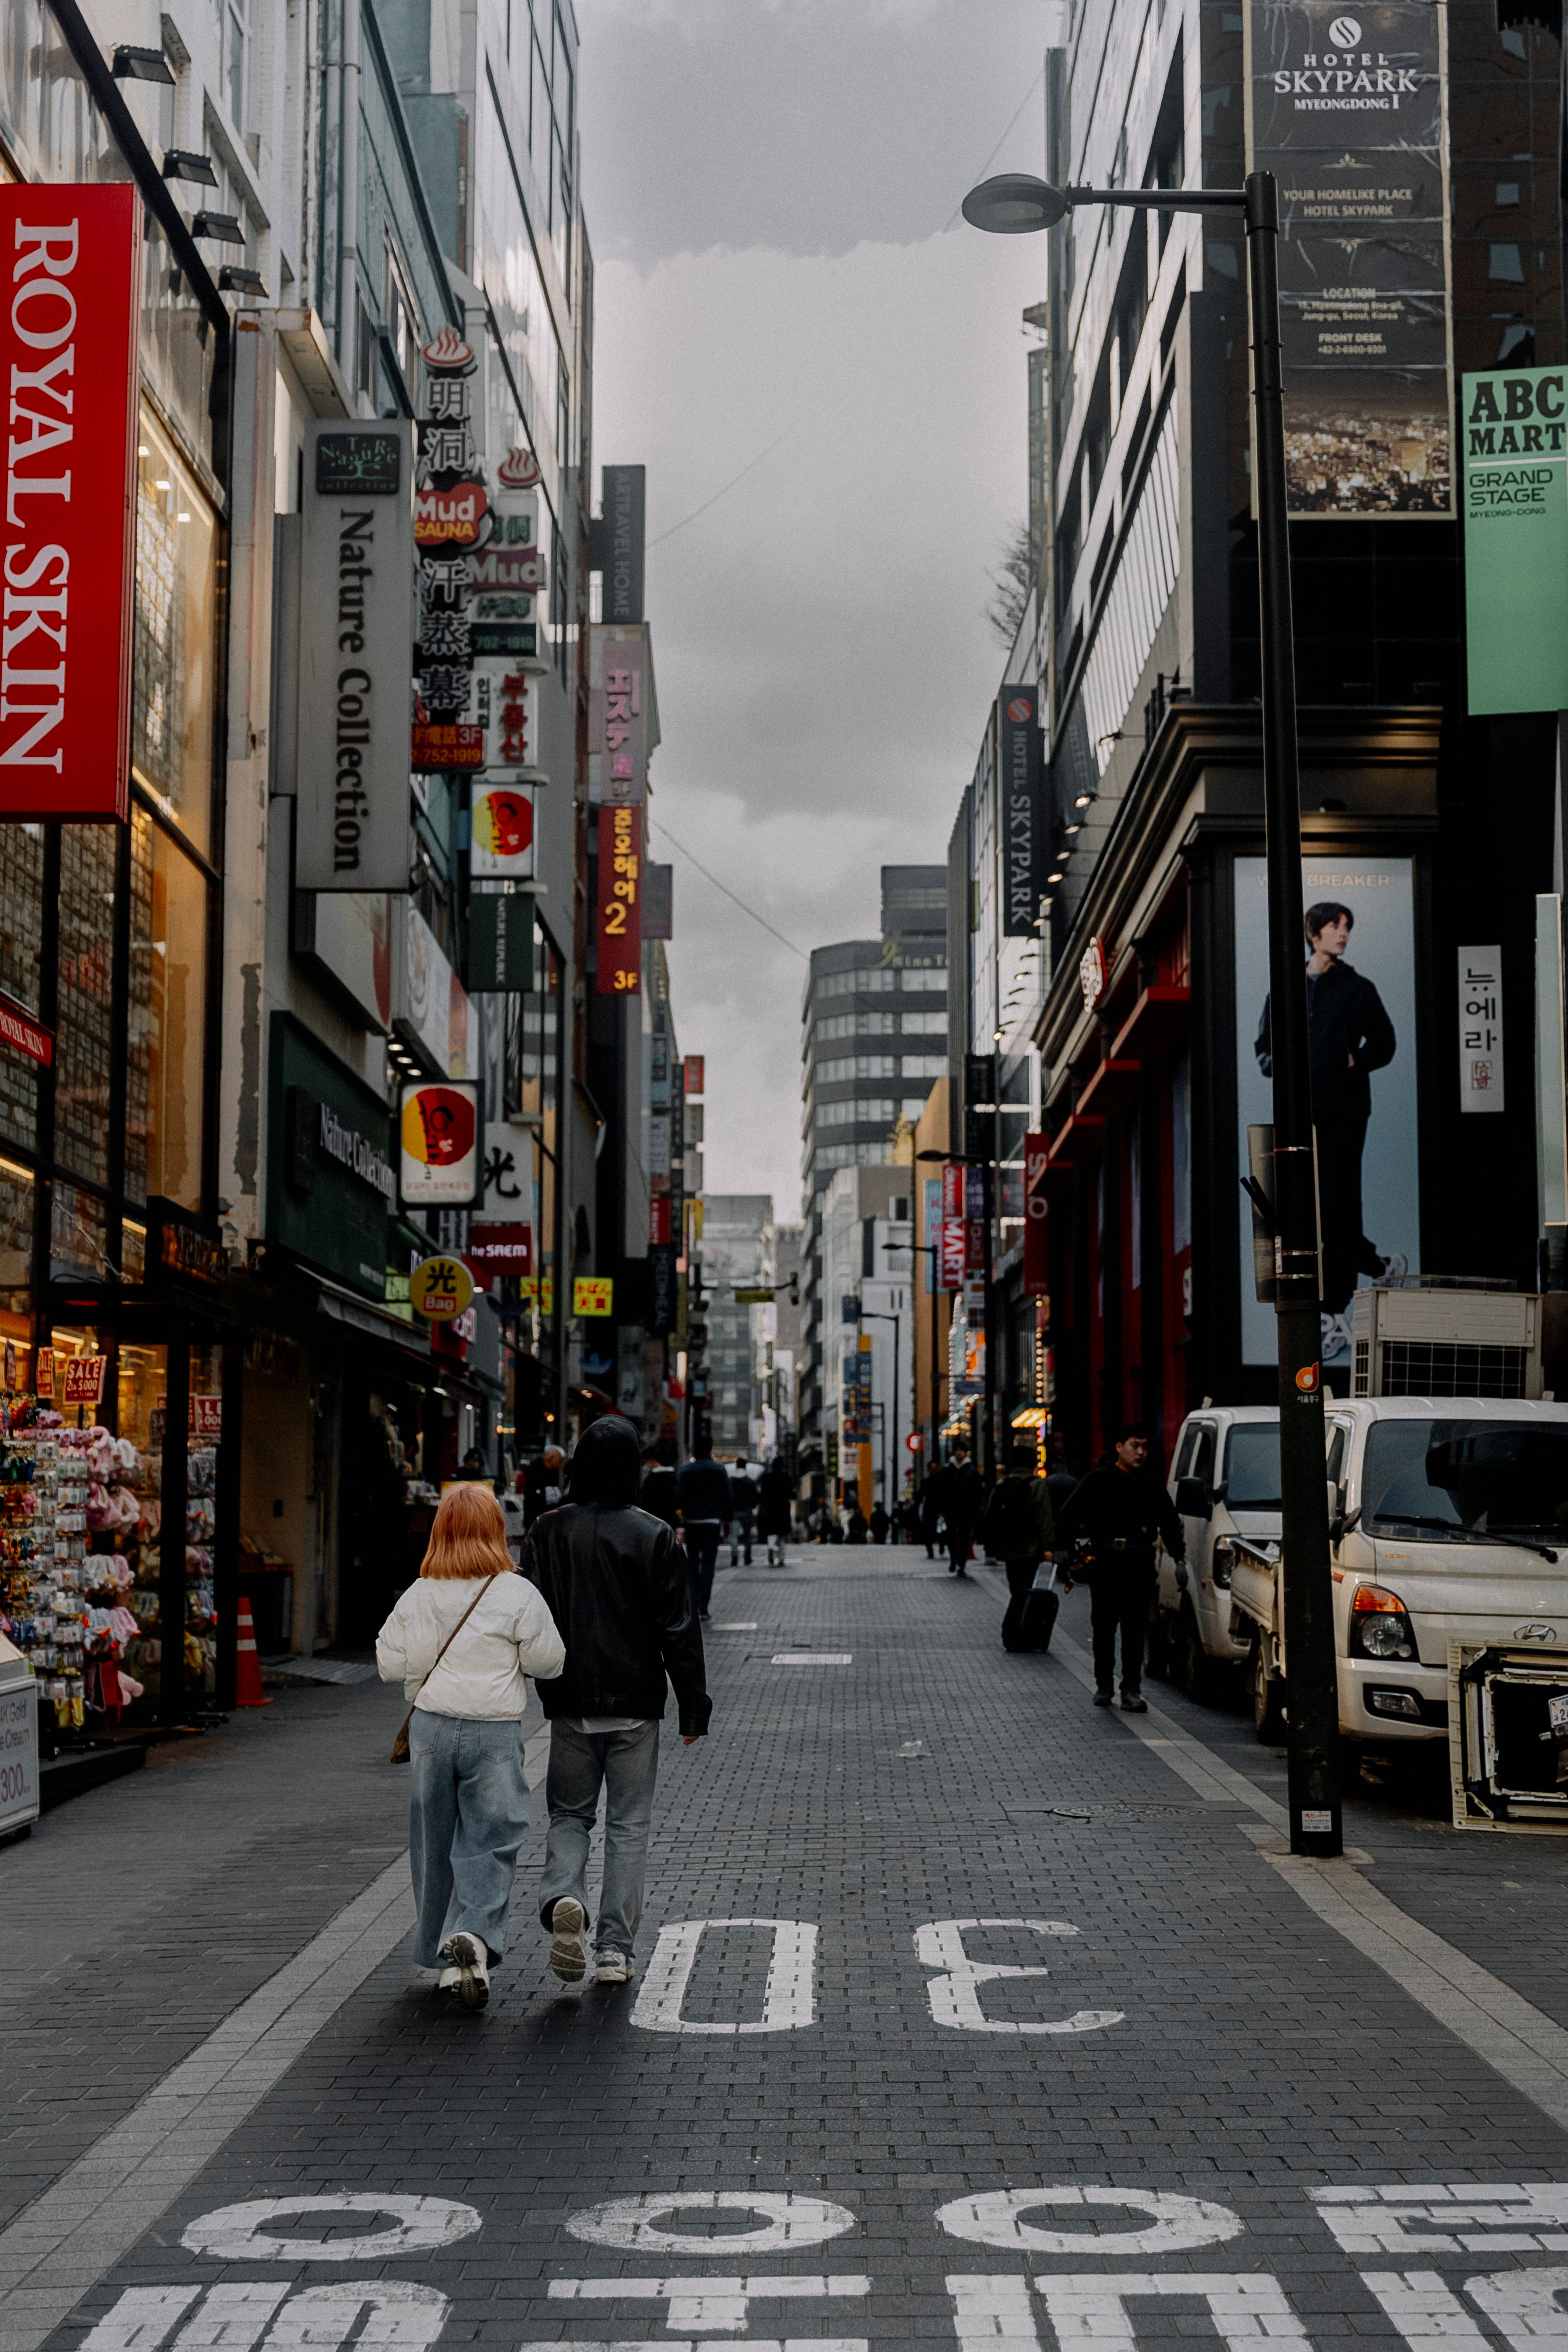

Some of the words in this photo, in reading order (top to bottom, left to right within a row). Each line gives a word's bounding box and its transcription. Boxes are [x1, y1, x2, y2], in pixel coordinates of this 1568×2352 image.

[1304, 53, 1389, 67] HOTEL
[1274, 69, 1418, 94] SKYPARK
[1295, 98, 1390, 110] MYEONGDONG
[1283, 189, 1315, 201] YOUR
[1317, 189, 1375, 201] HOMELIKE
[1378, 188, 1413, 200] PLACE
[1304, 205, 1339, 216] HOTEL
[1342, 205, 1394, 215] SKYPARK
[1323, 287, 1376, 299] LOCATION
[1371, 312, 1399, 320] Korea
[1318, 333, 1354, 343] FRONT
[1355, 333, 1383, 343] DESK
[6, 217, 79, 529] ROYAL
[1469, 376, 1565, 424] ABC
[424, 377, 470, 472] 明洞
[1469, 423, 1566, 456] MART
[1469, 469, 1553, 488] GRAND
[415, 494, 474, 522] Mud
[1470, 487, 1545, 506] STAGE
[1469, 507, 1546, 519] MYEONG-DONG
[414, 522, 474, 538] SAUNA
[338, 508, 374, 654] Nature
[468, 553, 545, 584] Mud
[614, 561, 631, 616] HOME
[0, 544, 70, 774] SKIN
[500, 673, 528, 762] 부동산
[606, 669, 630, 750] エステ
[458, 726, 481, 745] 3F
[334, 667, 372, 873] Collection
[1013, 731, 1028, 790] HOTEL
[1010, 794, 1032, 925] SKYPARK
[1307, 874, 1391, 887] BREAKER
[604, 902, 627, 935] 2
[613, 970, 638, 990] 3F
[25, 1028, 44, 1057] SKIN
[944, 1216, 964, 1286] MART
[425, 1262, 455, 1293] 光
[425, 1296, 455, 1311] Bag
[68, 1362, 99, 1379] SALE
[1297, 1395, 1319, 1403] 서울중구
